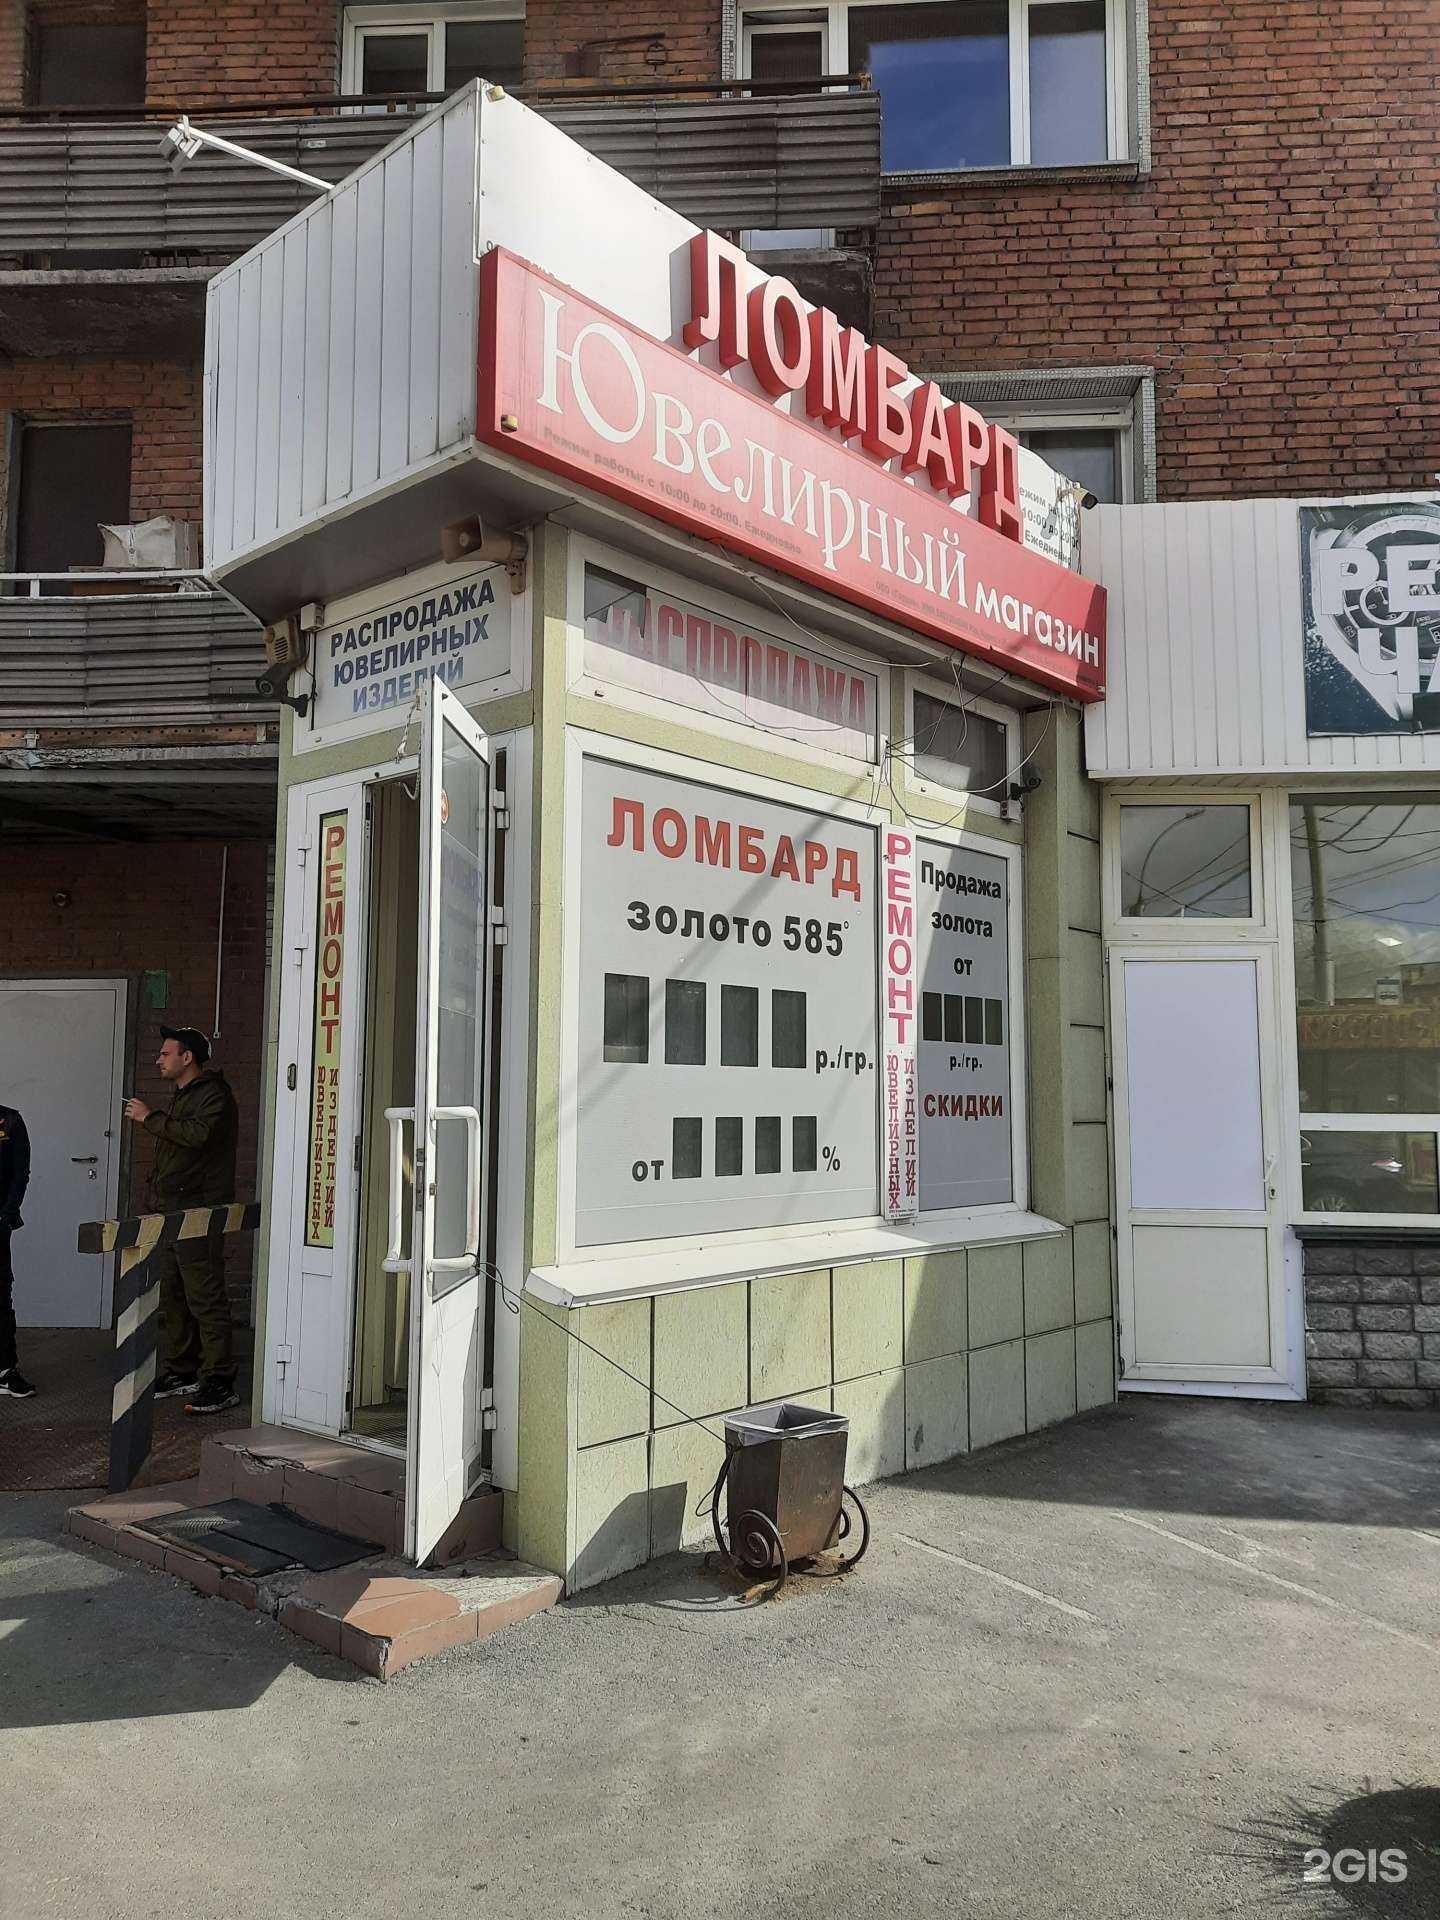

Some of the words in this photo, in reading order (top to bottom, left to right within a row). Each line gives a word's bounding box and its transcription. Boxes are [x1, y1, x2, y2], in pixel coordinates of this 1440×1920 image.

[685, 229, 1023, 544] ЛОМБАРД
[536, 287, 968, 608] Ювелирный
[974, 582, 1100, 668] магазин
[594, 452, 644, 483] работы:
[660, 482, 691, 504] 10:00
[692, 498, 706, 513] до
[1019, 486, 1046, 508] ежим
[330, 578, 495, 658] РАСПРОДАЖА
[333, 613, 489, 687] ЮВЕЛИРНЫХ
[607, 796, 861, 902] ЛОМБАРД
[920, 860, 1001, 900] Продажа
[321, 826, 345, 1054] РЕМОНТ
[627, 900, 772, 947] золото
[886, 833, 913, 1045] РЕМОНТ
[931, 910, 993, 938] золота
[953, 957, 972, 976] от
[815, 1046, 874, 1073] р./гр.
[949, 1053, 983, 1072] р./гр.
[311, 1066, 327, 1241] ЮВЕЛИРНЫХ
[324, 1068, 339, 1229] ИЗДЕЛИЙ
[632, 1160, 664, 1182] от
[822, 1145, 840, 1172] %
[887, 1054, 900, 1210] ЮВЕЛИРНЫХ
[904, 1058, 916, 1198] ИЗДЕЛИЙ
